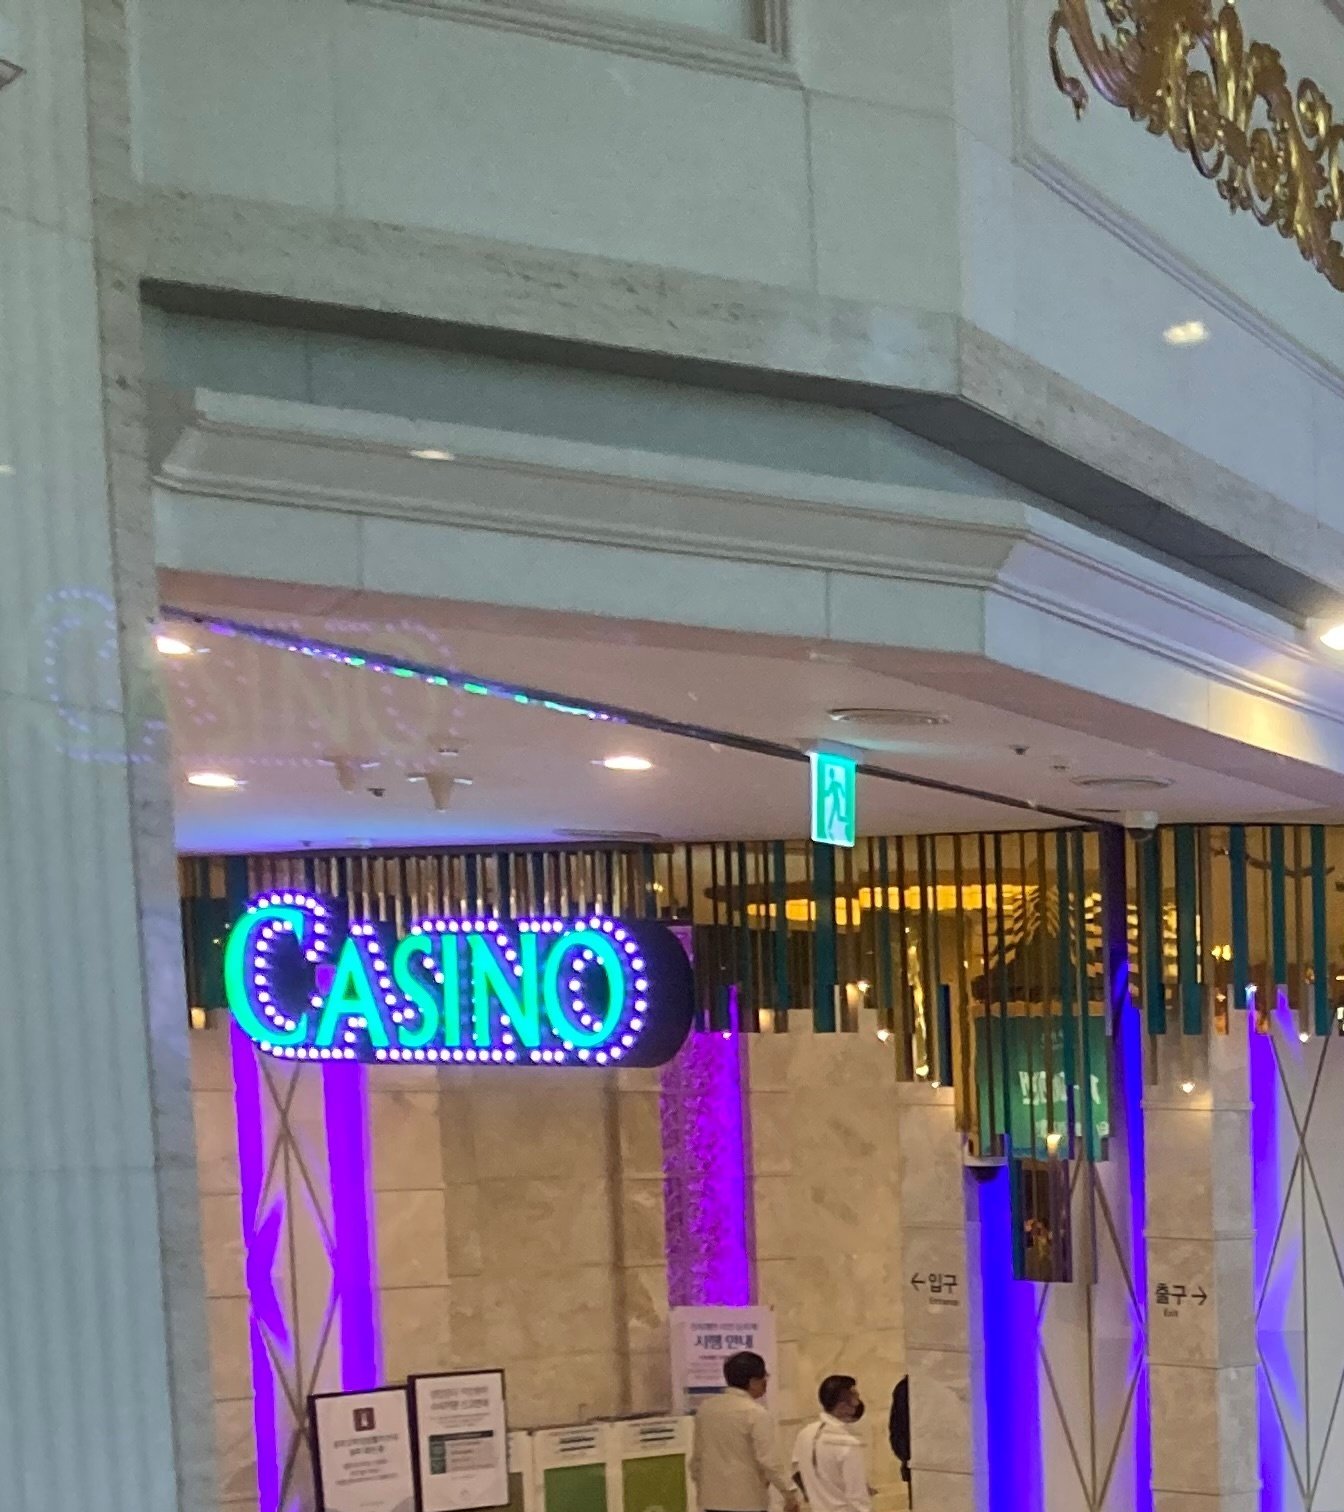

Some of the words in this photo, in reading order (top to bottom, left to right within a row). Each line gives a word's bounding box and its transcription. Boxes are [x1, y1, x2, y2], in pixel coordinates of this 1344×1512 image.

[225, 903, 632, 1050] CASINO
[928, 1273, 959, 1294] 입구
[1155, 1282, 1187, 1306] 출구
